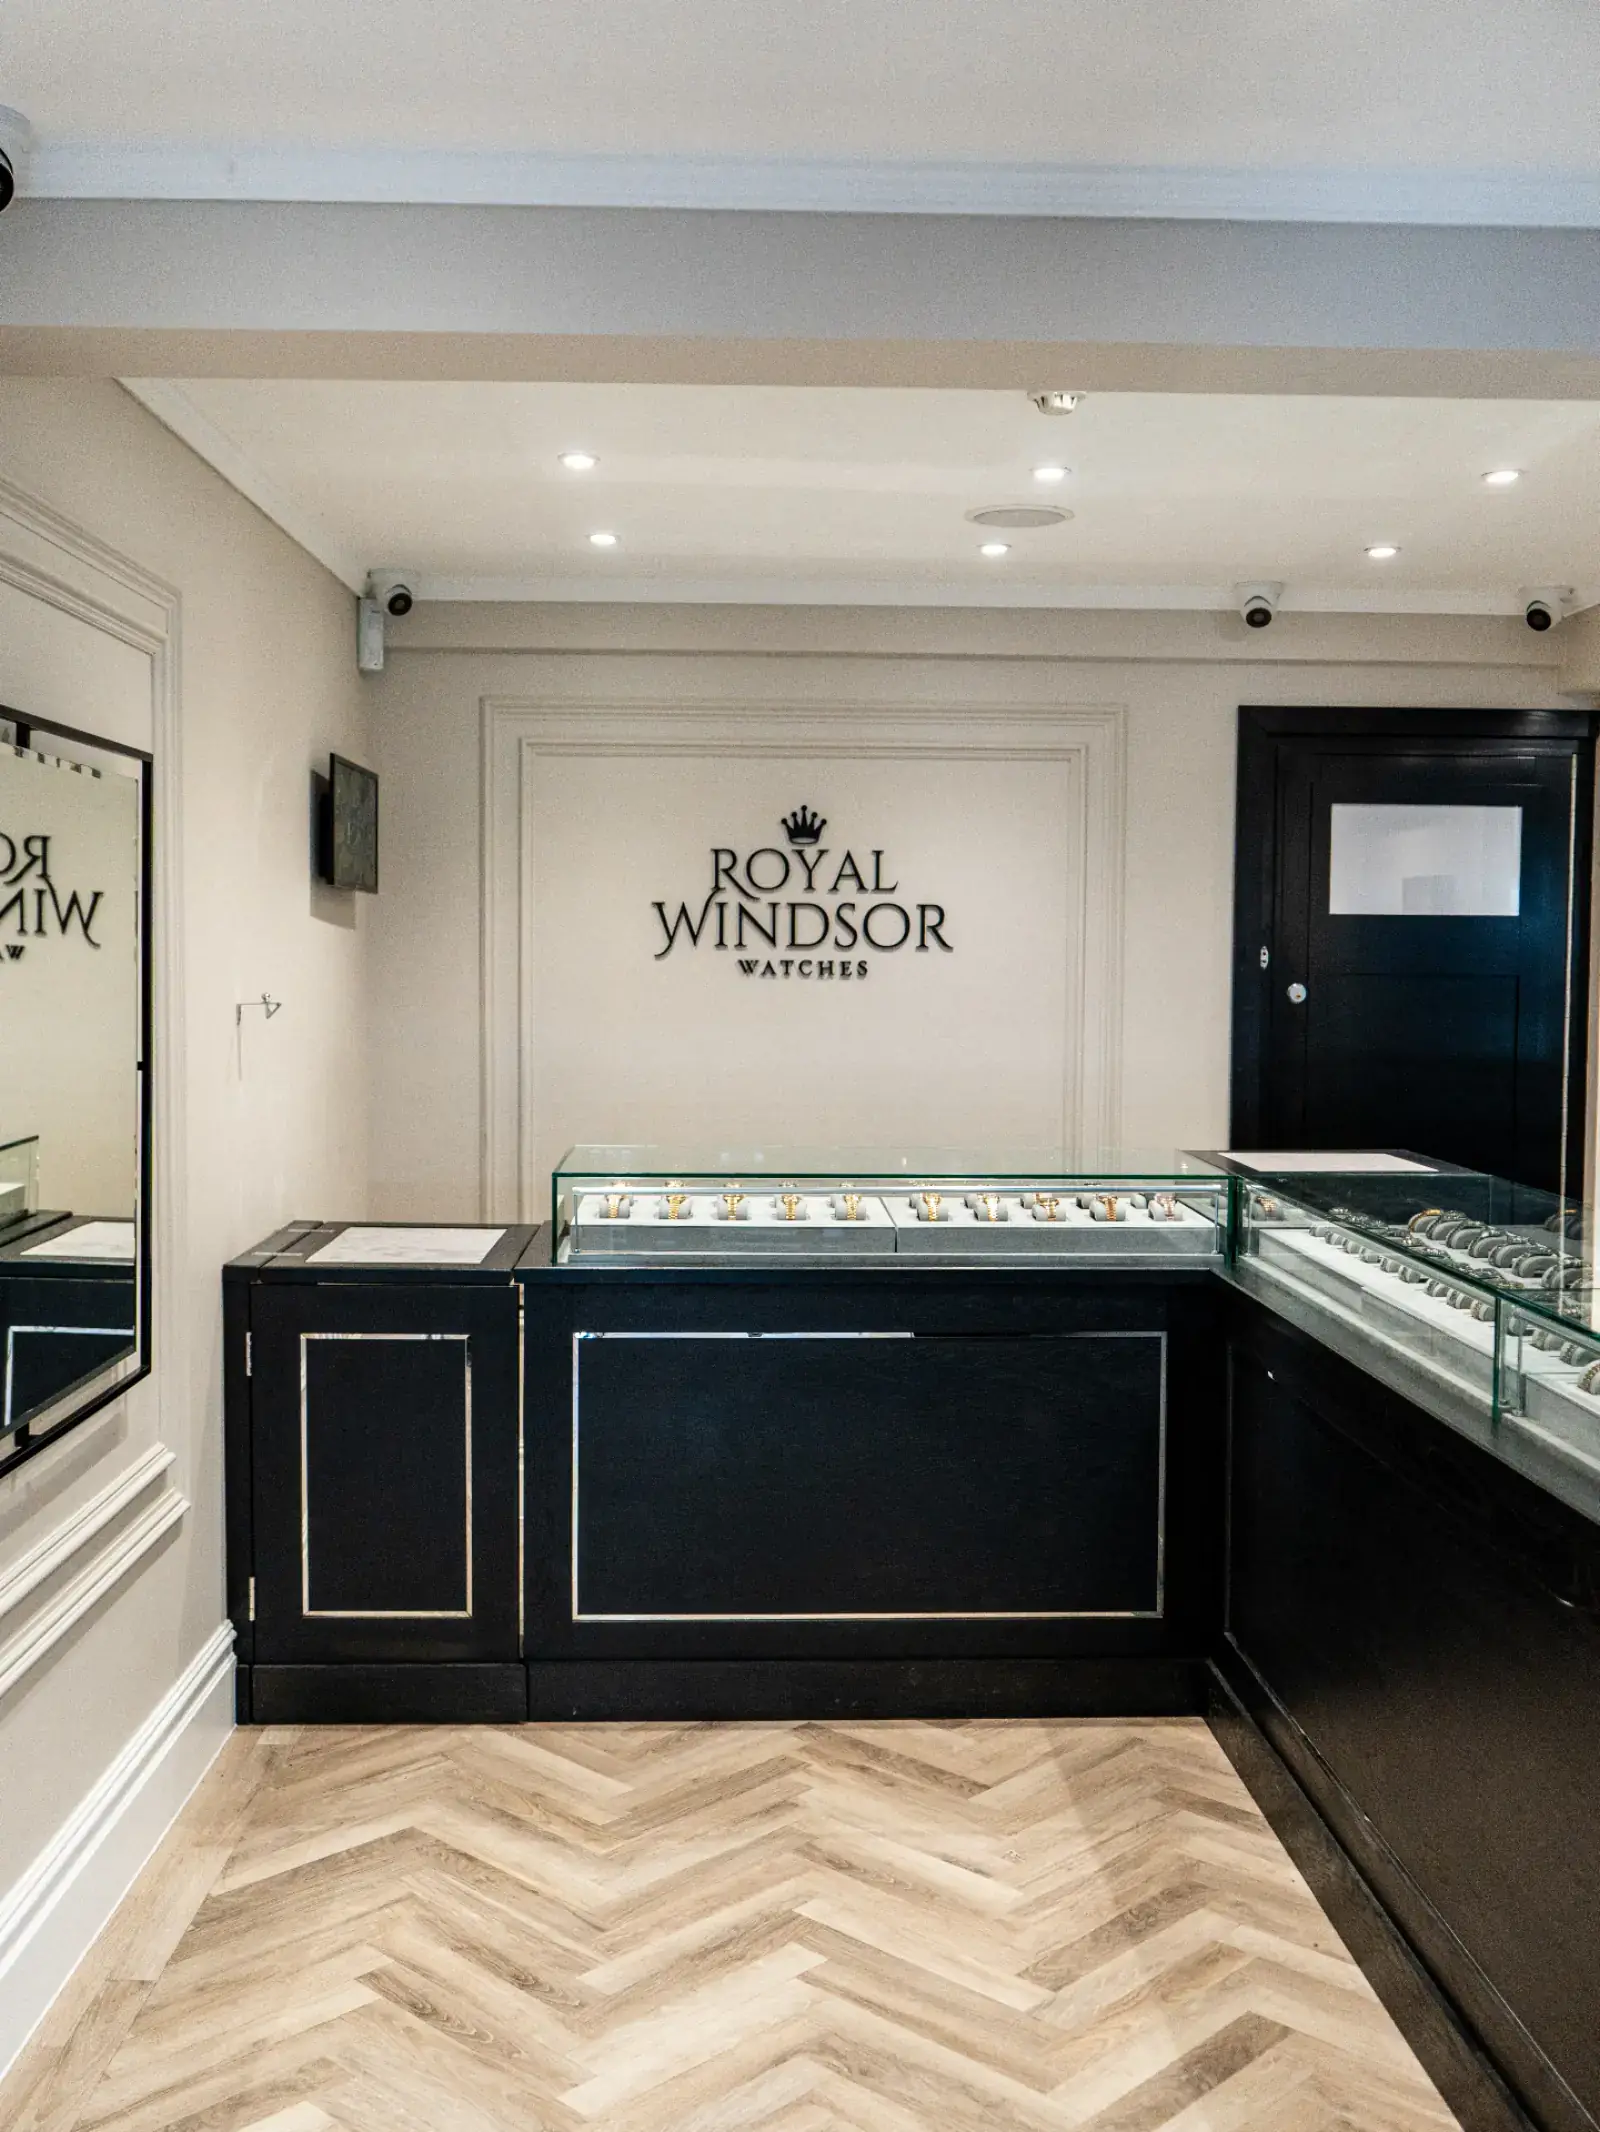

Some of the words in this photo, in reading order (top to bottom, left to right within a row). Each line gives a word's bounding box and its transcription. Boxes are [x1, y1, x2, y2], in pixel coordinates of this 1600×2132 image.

[711, 848, 899, 901] ROYAL
[651, 888, 953, 960] WINDSOR
[738, 959, 869, 979] WATCHES
